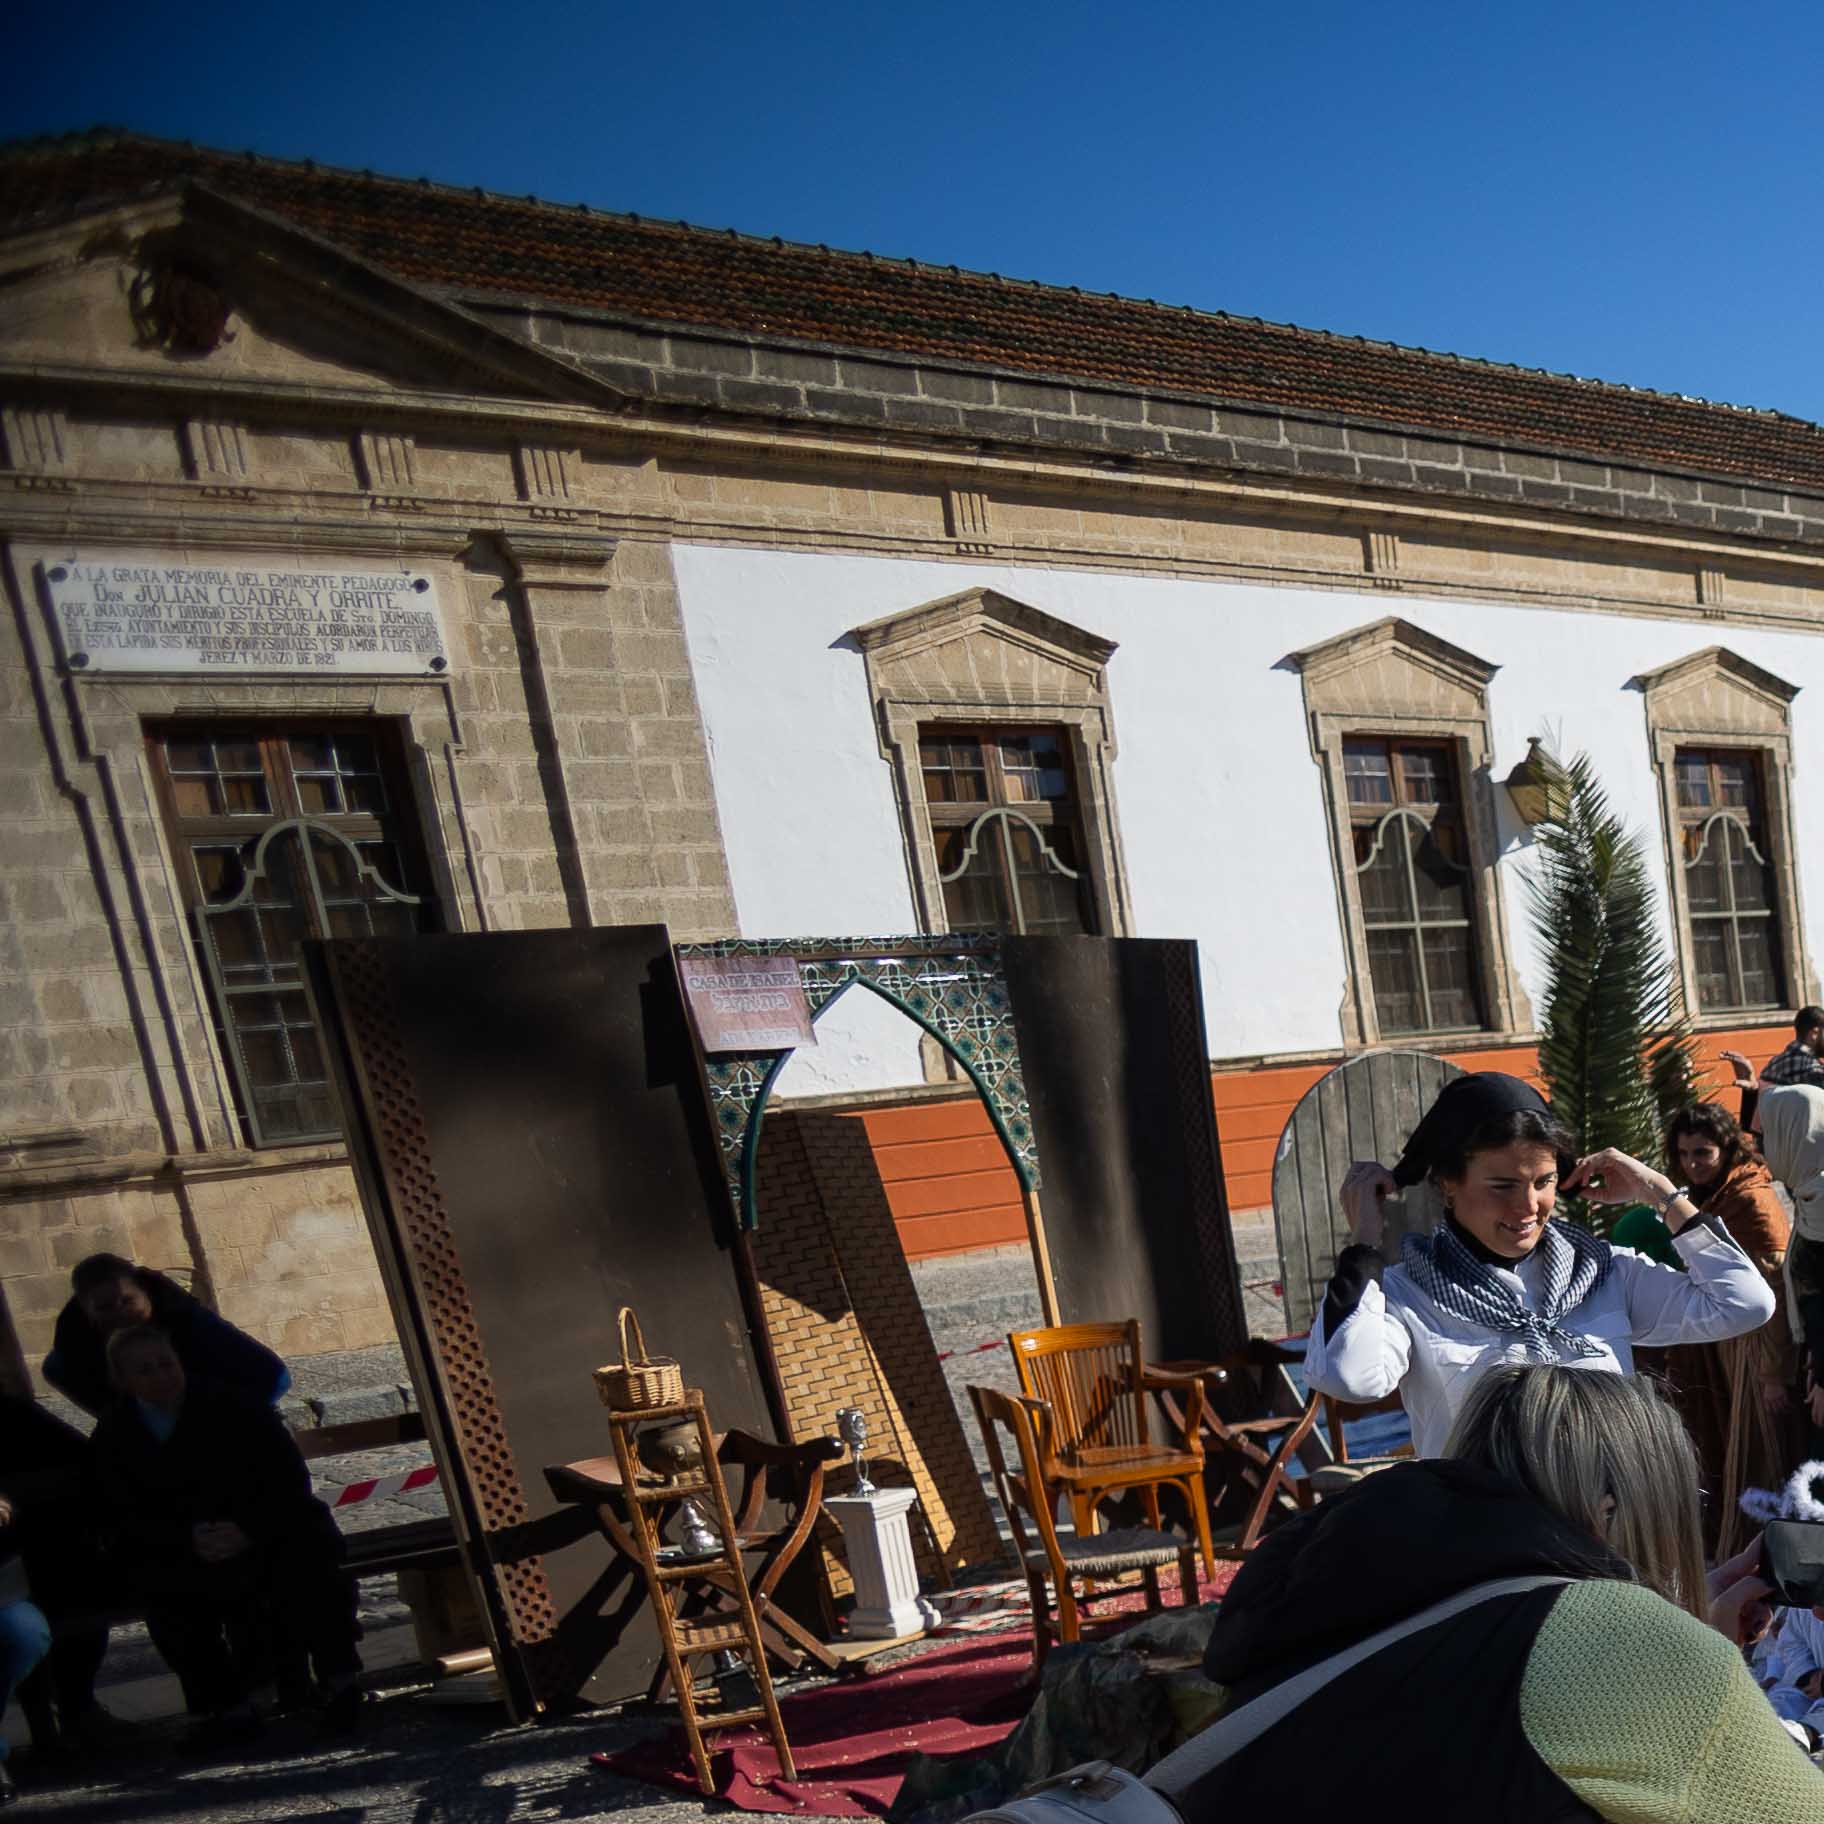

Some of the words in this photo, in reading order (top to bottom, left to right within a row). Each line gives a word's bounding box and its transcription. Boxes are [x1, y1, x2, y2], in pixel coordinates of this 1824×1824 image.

[72, 567, 82, 580] A
[86, 567, 108, 583] LA
[112, 568, 160, 583] GRATA
[165, 568, 232, 586] MEMORIA
[236, 572, 264, 587] DEL
[269, 573, 338, 589] EMINENTE
[341, 575, 414, 592] PEDAGOGO
[218, 586, 302, 607] CUADRA
[305, 588, 320, 607] Y
[60, 602, 89, 617] QUE
[165, 604, 174, 618] Y
[231, 606, 264, 620] ESTA
[270, 607, 328, 622] ESCUELA
[331, 608, 348, 622] DE
[127, 619, 211, 634] AYUNTAMIENTO
[223, 621, 245, 636] SUS
[316, 623, 377, 638] ACORDARON
[159, 635, 182, 649] SUS
[234, 636, 319, 651] PROFESIONALES
[331, 638, 345, 652] SU
[349, 638, 377, 652] AMOR
[391, 639, 412, 653] LOS
[199, 650, 239, 665] JEREZ
[250, 651, 294, 665] MARZO
[297, 651, 312, 665] DE
[688, 975, 727, 991] CASA
[728, 973, 747, 989] DE
